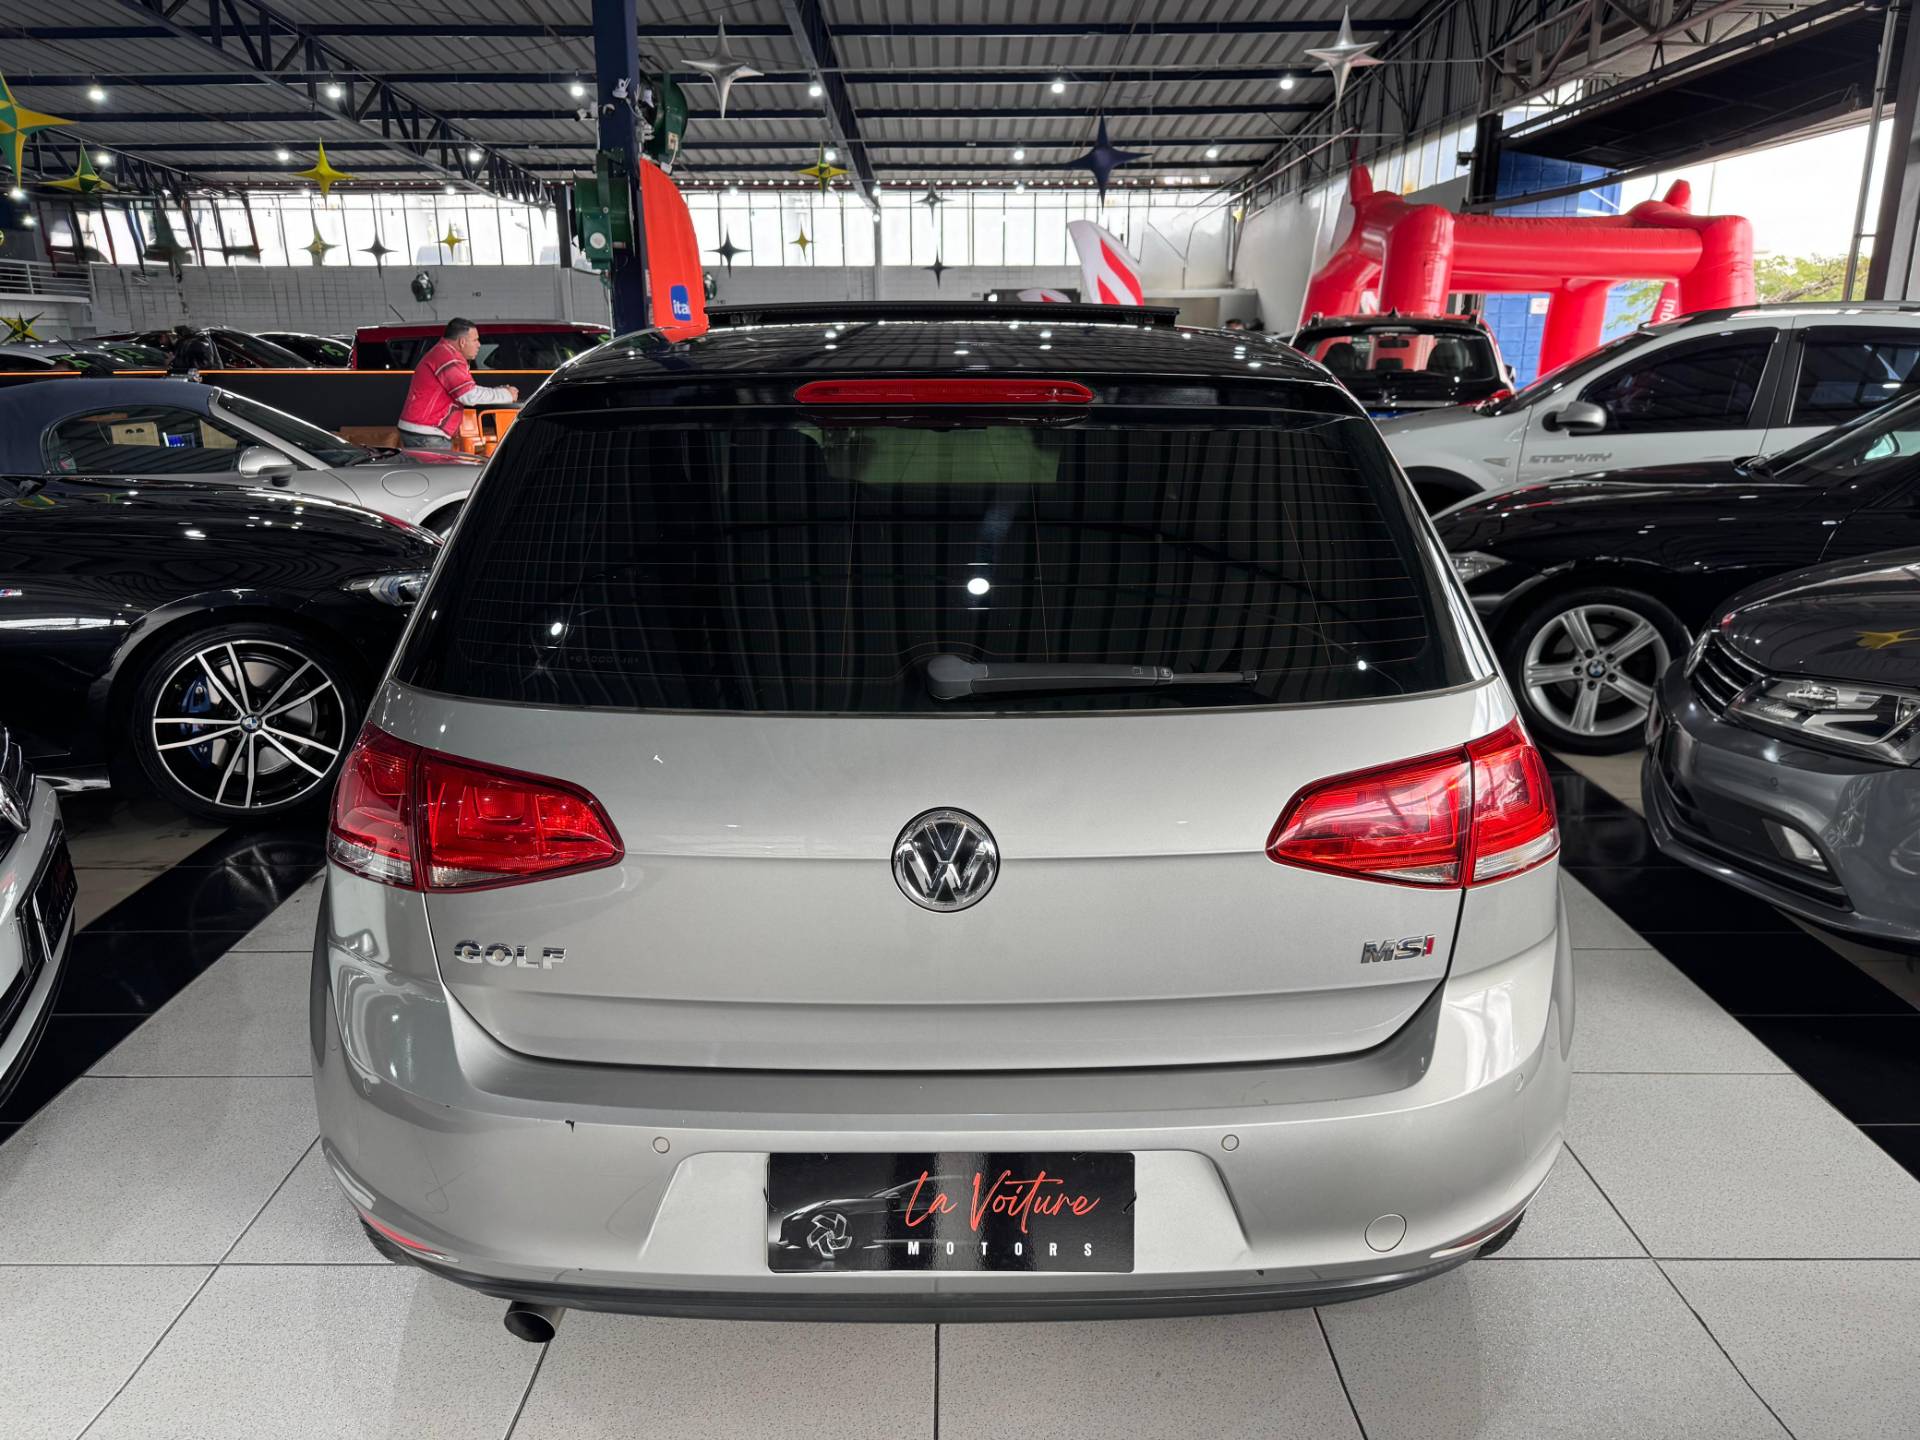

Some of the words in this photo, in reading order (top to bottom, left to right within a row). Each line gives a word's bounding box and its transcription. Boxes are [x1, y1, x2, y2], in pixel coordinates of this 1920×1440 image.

[673, 300, 691, 315] ita
[454, 940, 566, 970] GOLF
[1361, 933, 1436, 964] MSI
[905, 1170, 957, 1228] La
[970, 1170, 1100, 1234] Voiture
[908, 1241, 1092, 1257] MOTORS
